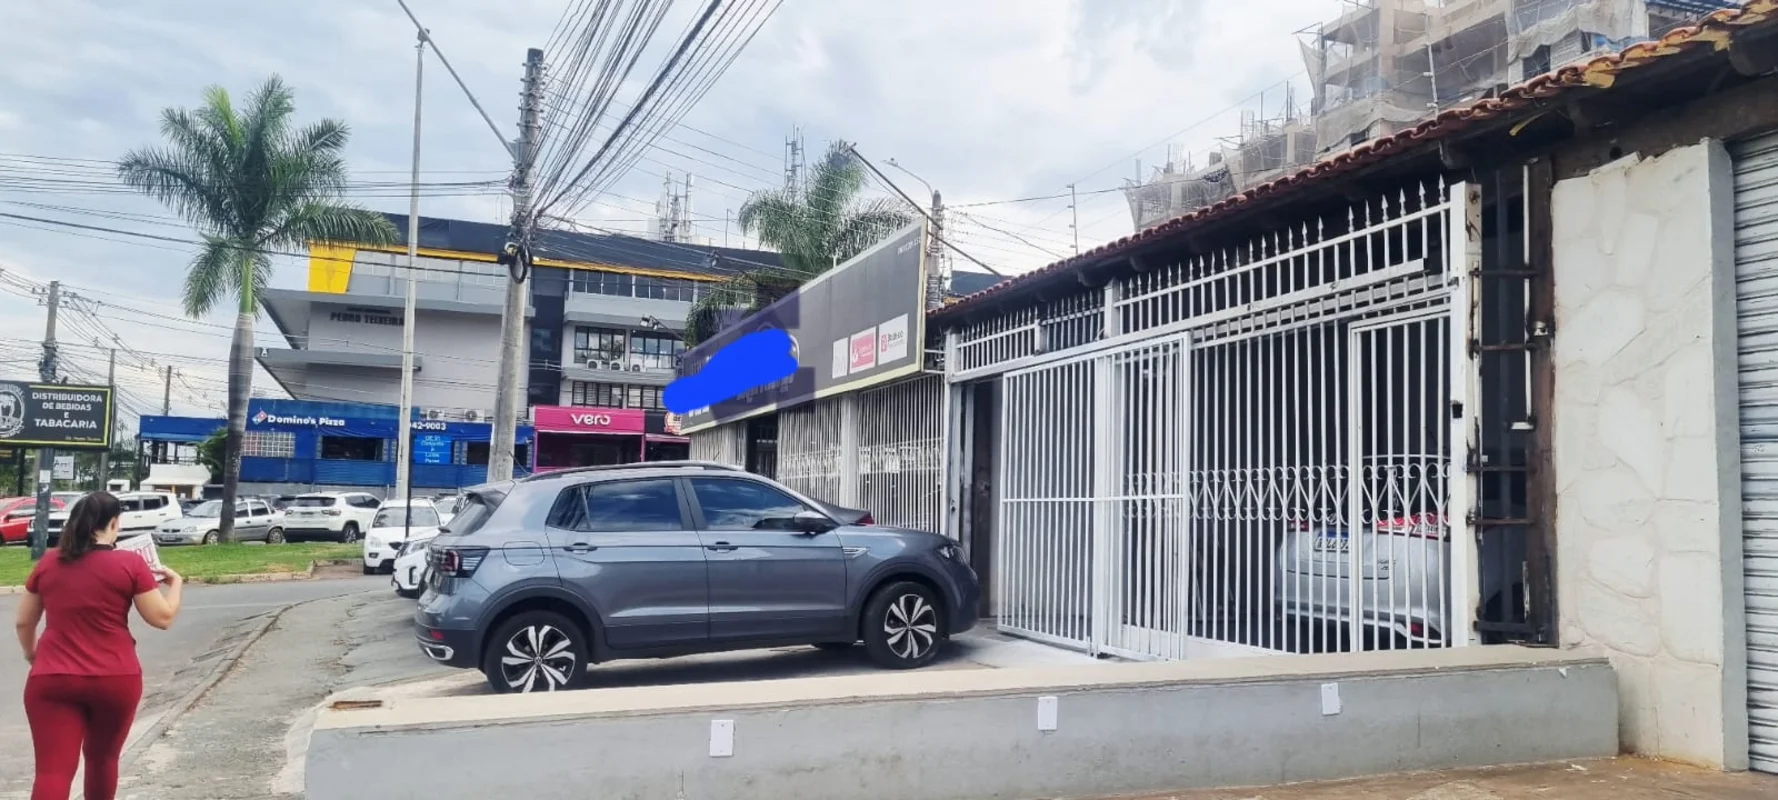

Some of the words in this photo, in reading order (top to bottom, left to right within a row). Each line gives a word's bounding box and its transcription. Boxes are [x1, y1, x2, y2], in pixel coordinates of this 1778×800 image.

[330, 312, 361, 323] PEDRO
[260, 347, 268, 358] A
[32, 392, 102, 402] DISTRIBUIDORA
[42, 402, 54, 410] DE
[55, 402, 92, 411] BEBIDAS
[63, 411, 70, 419] E
[267, 414, 316, 425] Domino's
[318, 417, 345, 426] Pizza
[570, 413, 611, 425] vero
[34, 418, 97, 429] TABACARIA
[409, 421, 447, 430] 42-9003
